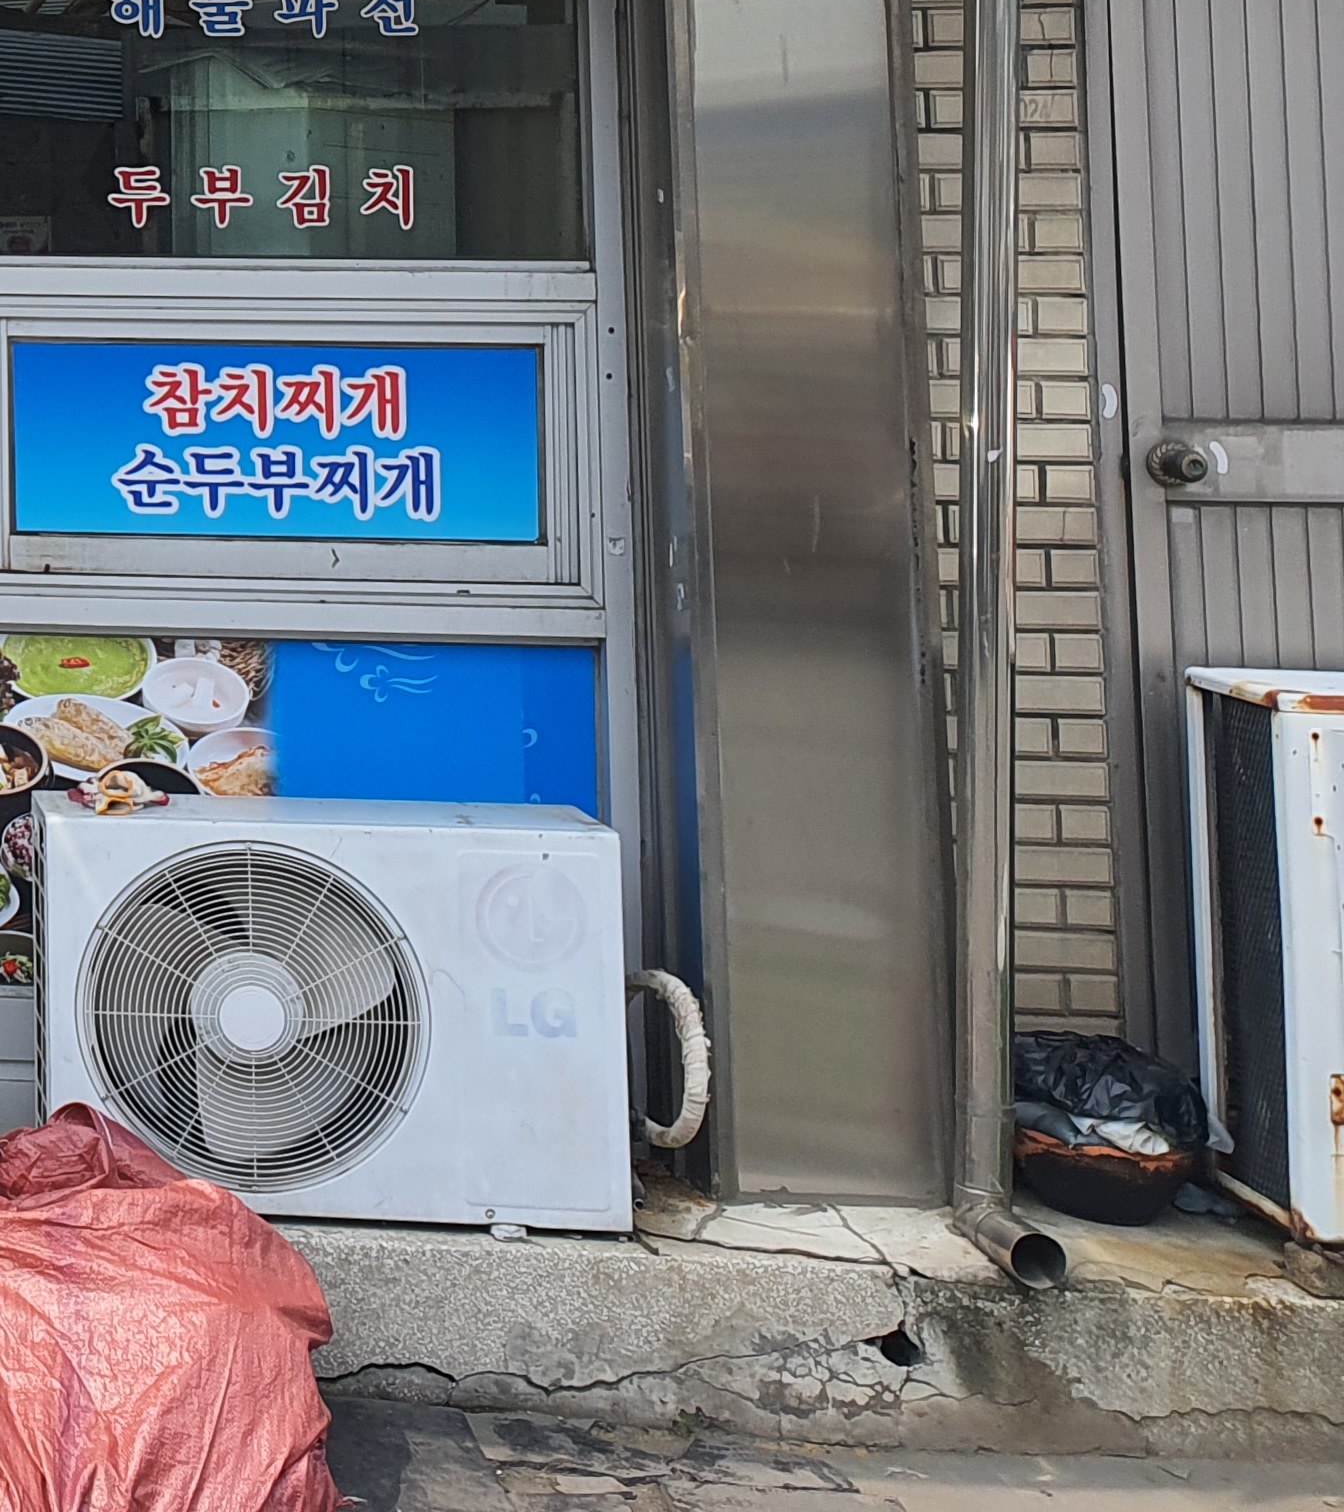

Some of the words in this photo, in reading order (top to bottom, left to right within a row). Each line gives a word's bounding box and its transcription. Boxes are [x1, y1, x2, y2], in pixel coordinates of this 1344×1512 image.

[108, 164, 415, 229] 두부김치
[143, 363, 409, 441] 참치찌개
[112, 444, 441, 520] 순두부찌개
[490, 987, 579, 1039] LG
